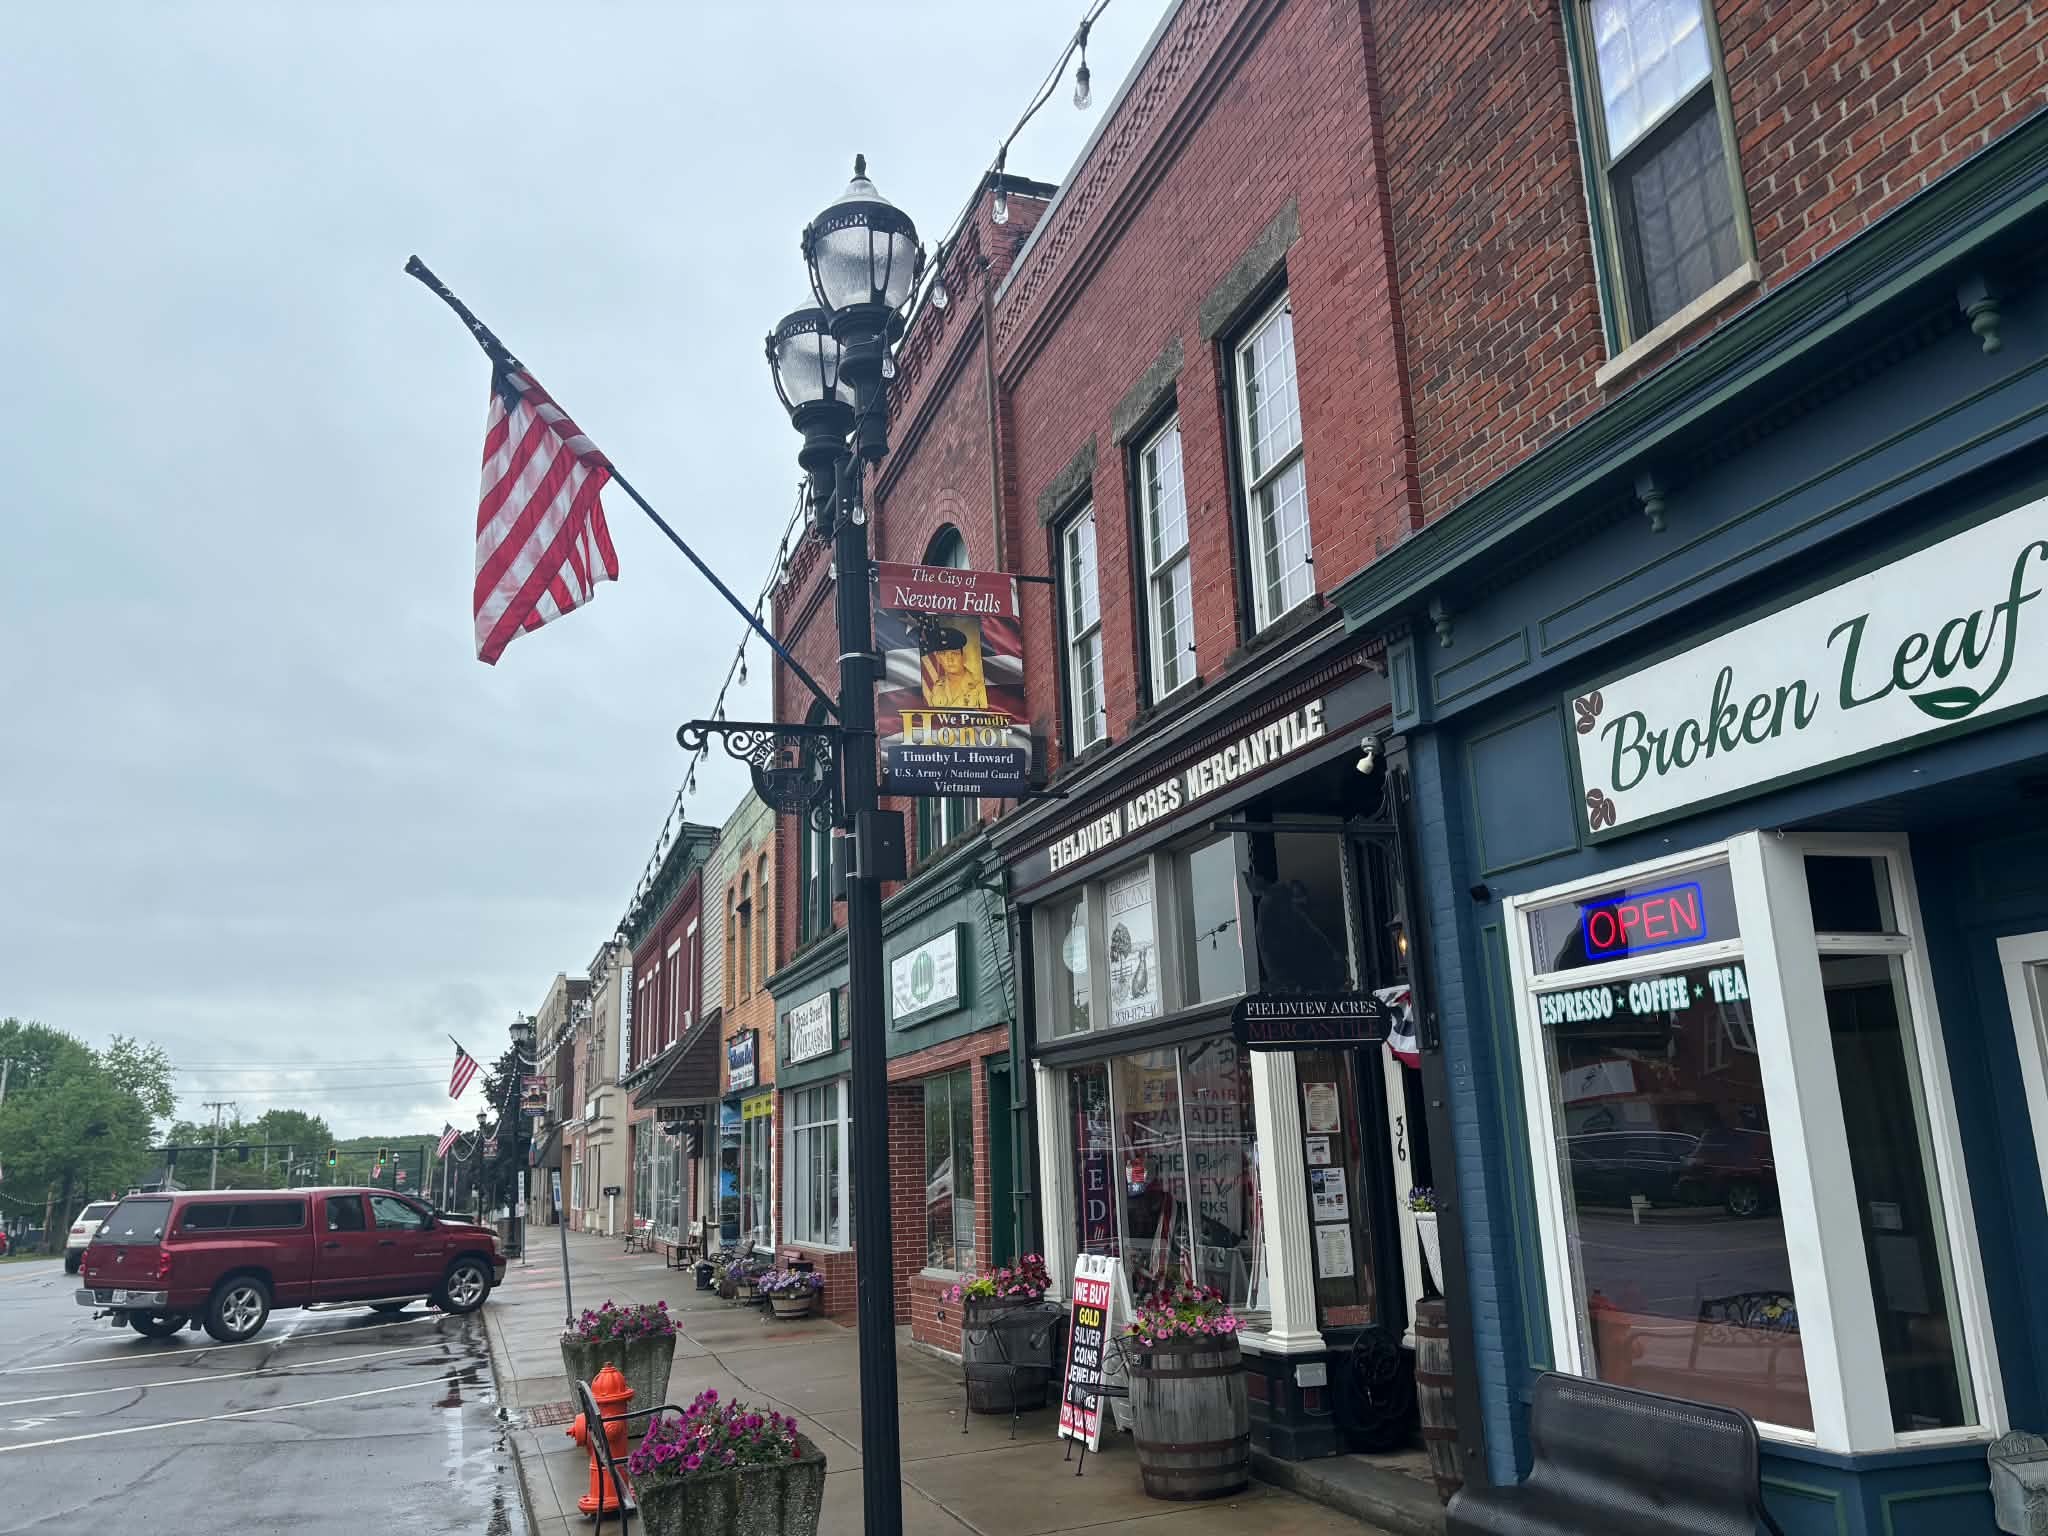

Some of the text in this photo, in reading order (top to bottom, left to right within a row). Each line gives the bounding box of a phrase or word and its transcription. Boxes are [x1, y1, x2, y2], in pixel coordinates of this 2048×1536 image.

[912, 569, 977, 588] The City of
[894, 586, 1001, 614] Newton Falls
[1601, 540, 2048, 793] Broken Leaf
[901, 712, 1013, 747] Honor
[937, 713, 1011, 728] We Proudly
[901, 751, 1014, 765] Timothy L. Howard
[895, 768, 914, 777] U.S.
[916, 769, 942, 780] Army
[951, 769, 988, 779] National
[991, 770, 1020, 779] Guard
[934, 782, 981, 793] Vietnam
[1049, 698, 1326, 873] FIELDVIEW ACRES MERCANTILE
[1589, 892, 1698, 948] OPEN
[1538, 966, 1749, 1025] ESPRESSO COFFEE TEA
[1247, 1001, 1377, 1016] FIELDVIEW ACRES
[1249, 1022, 1377, 1040] MERCANTILE
[1075, 1281, 1107, 1305] WE BUY
[1079, 1307, 1100, 1327] GOLD
[1075, 1326, 1101, 1347] SILVER
[1074, 1345, 1098, 1367] COINS
[1068, 1364, 1100, 1385] JEWELRY
[1067, 1383, 1073, 1401] &
